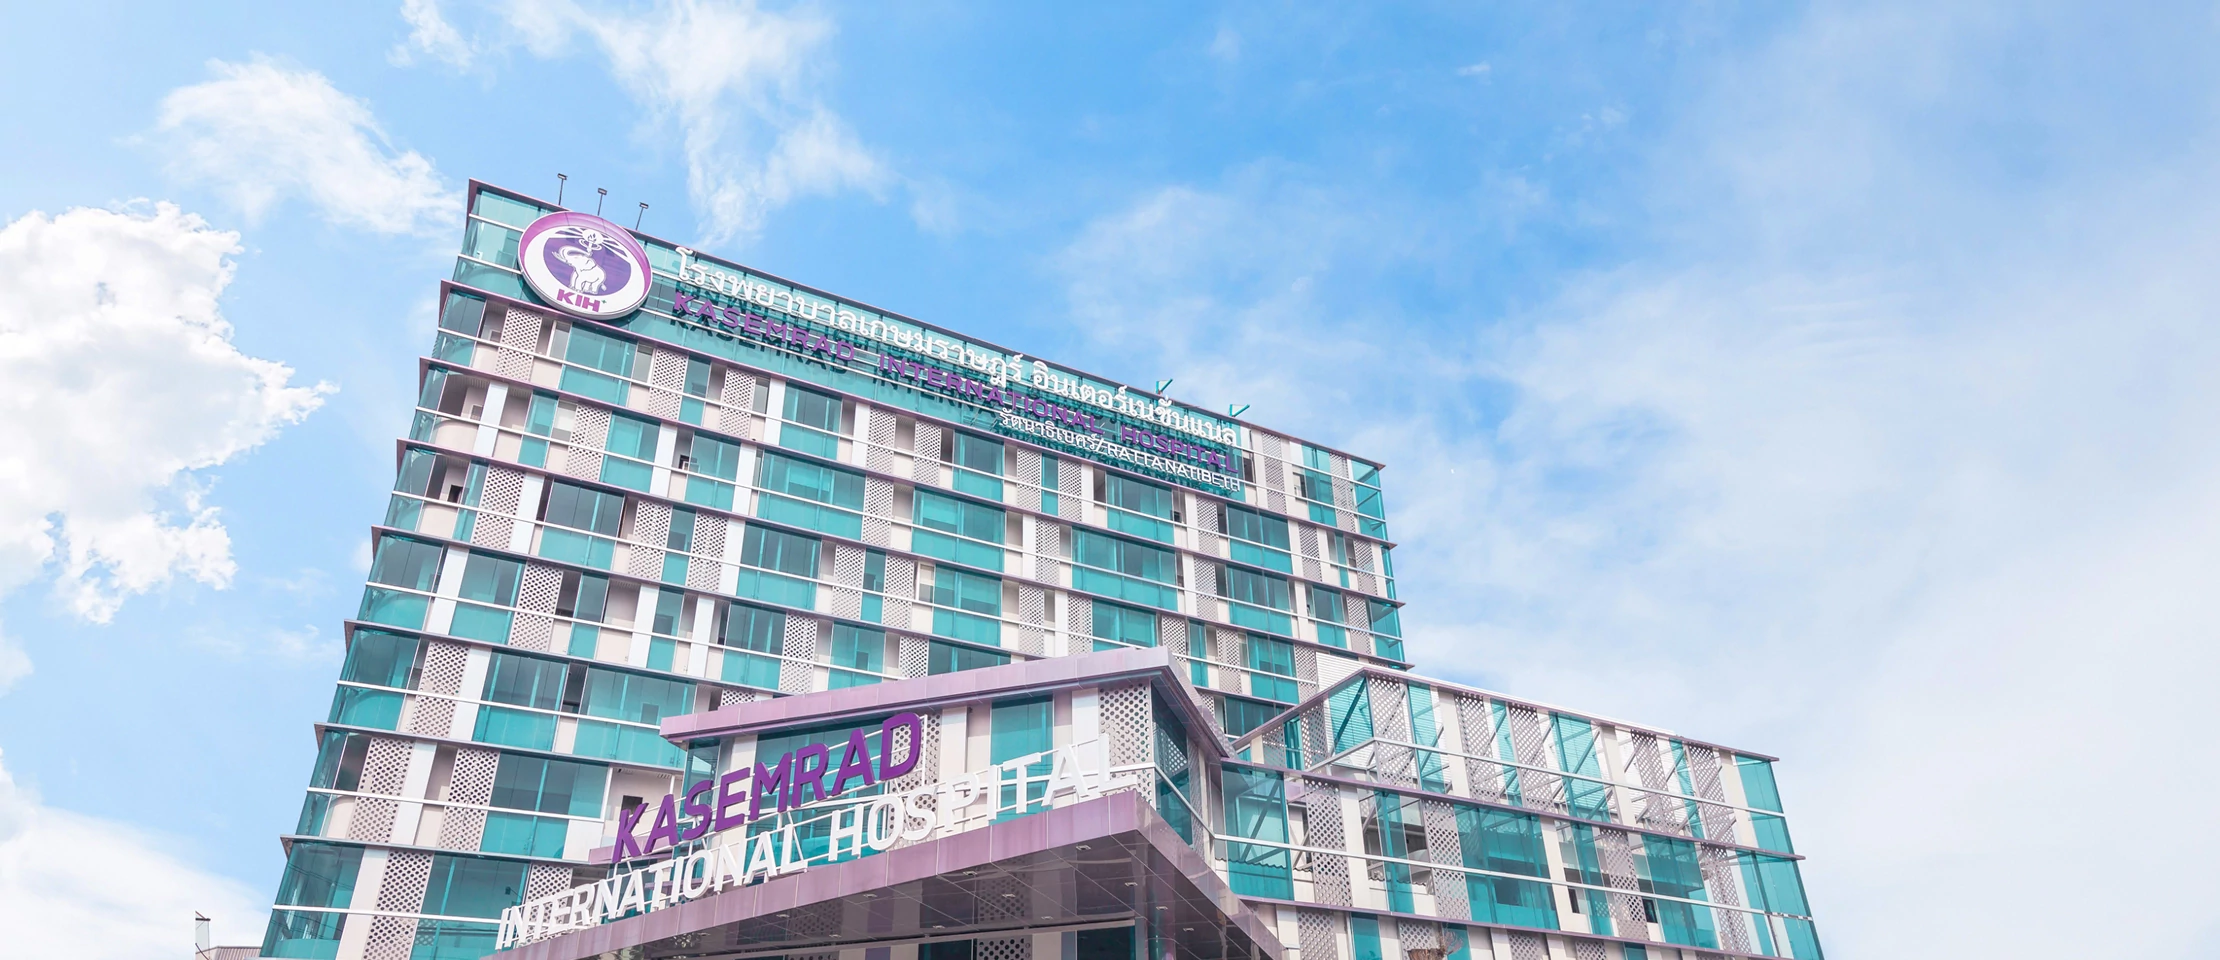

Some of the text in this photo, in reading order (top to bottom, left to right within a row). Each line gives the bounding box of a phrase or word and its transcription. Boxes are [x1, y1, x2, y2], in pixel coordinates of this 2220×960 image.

[557, 288, 601, 313] KIH
[673, 291, 1239, 474] KASEMRAD INTERNATIONAL HOSPITAL
[674, 246, 1238, 447] โรงพยาบาลเกษมราษฎร์ อินเตอร์เนชั่นแนล
[495, 733, 1137, 950] INTERNATIONAL HOSPITAL
[611, 712, 923, 864] KASEMRAD
